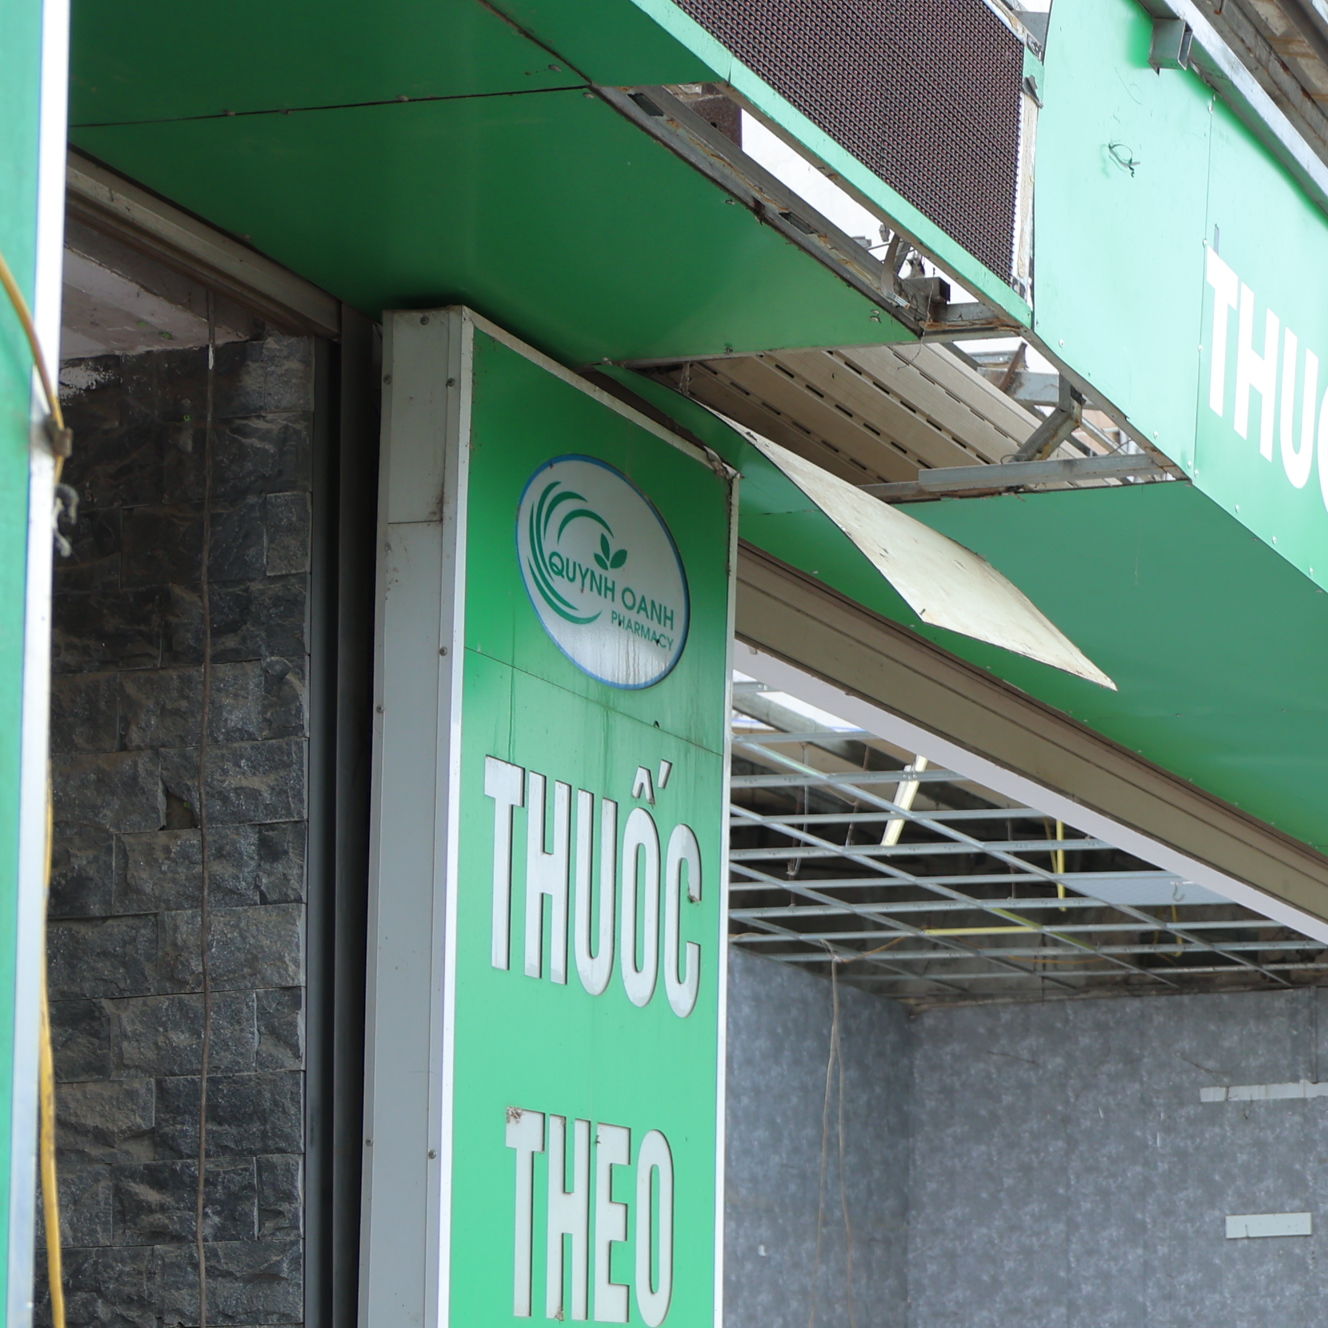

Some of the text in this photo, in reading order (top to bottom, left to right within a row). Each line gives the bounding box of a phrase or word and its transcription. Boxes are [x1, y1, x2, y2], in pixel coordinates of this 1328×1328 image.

[611, 610, 674, 651] PHARMACY
[621, 587, 674, 631] OANH
[484, 754, 701, 1018] THUỐC
[505, 1106, 674, 1328] THEO
